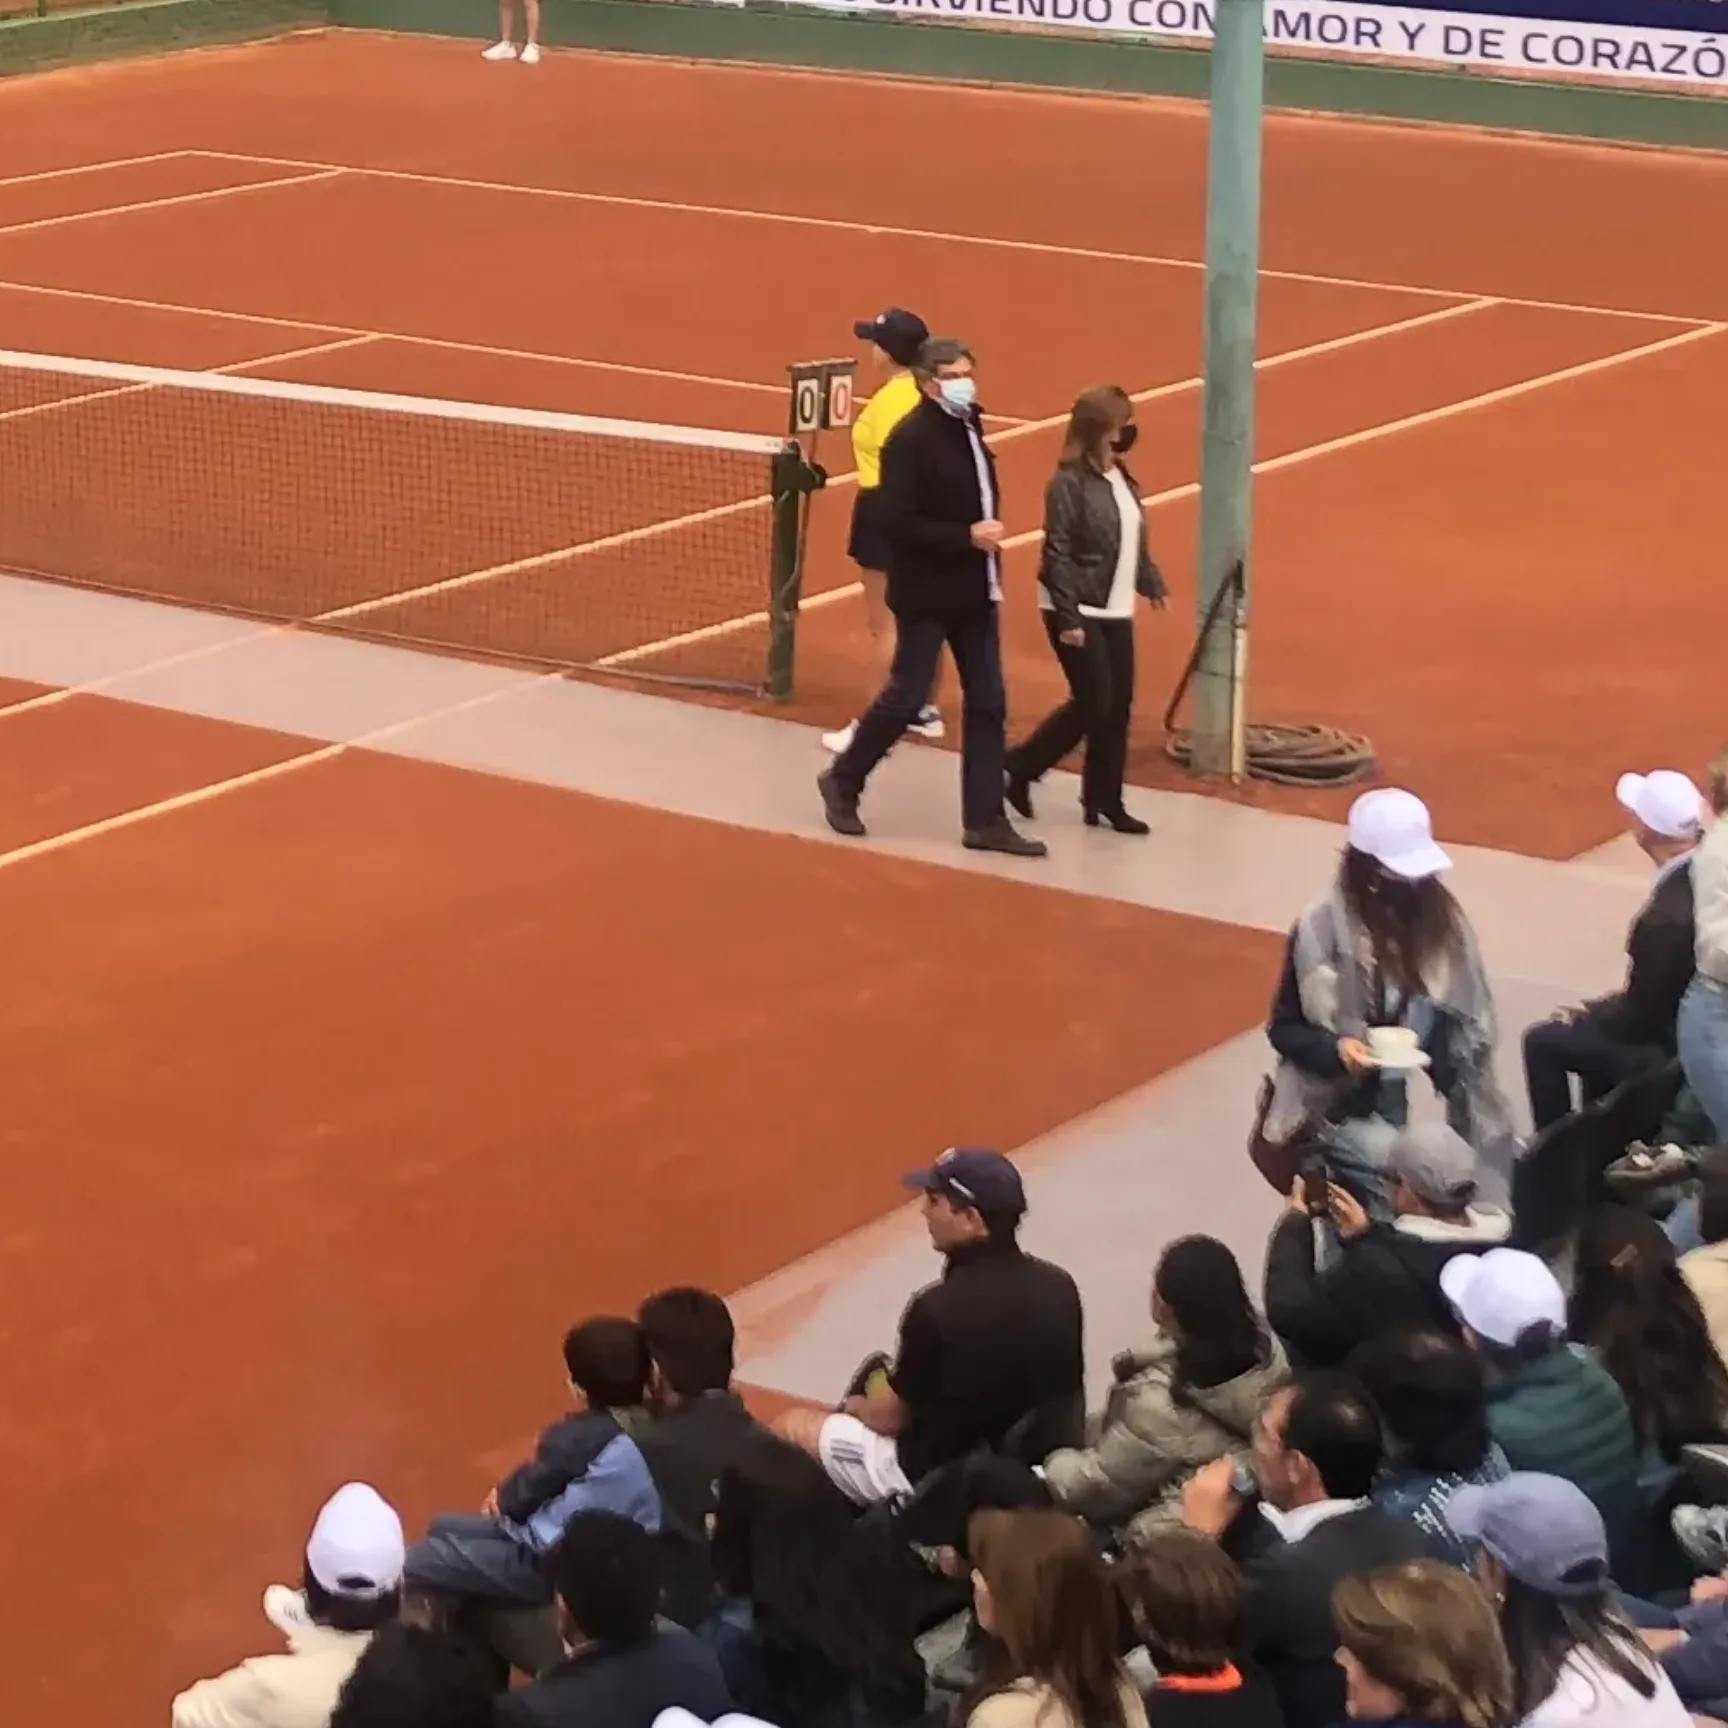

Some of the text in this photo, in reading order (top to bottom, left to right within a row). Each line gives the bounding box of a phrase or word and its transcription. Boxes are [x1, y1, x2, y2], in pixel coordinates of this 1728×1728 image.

[1264, 8, 1382, 48] MOR
[1398, 20, 1426, 52] Y
[1442, 25, 1505, 57] DE
